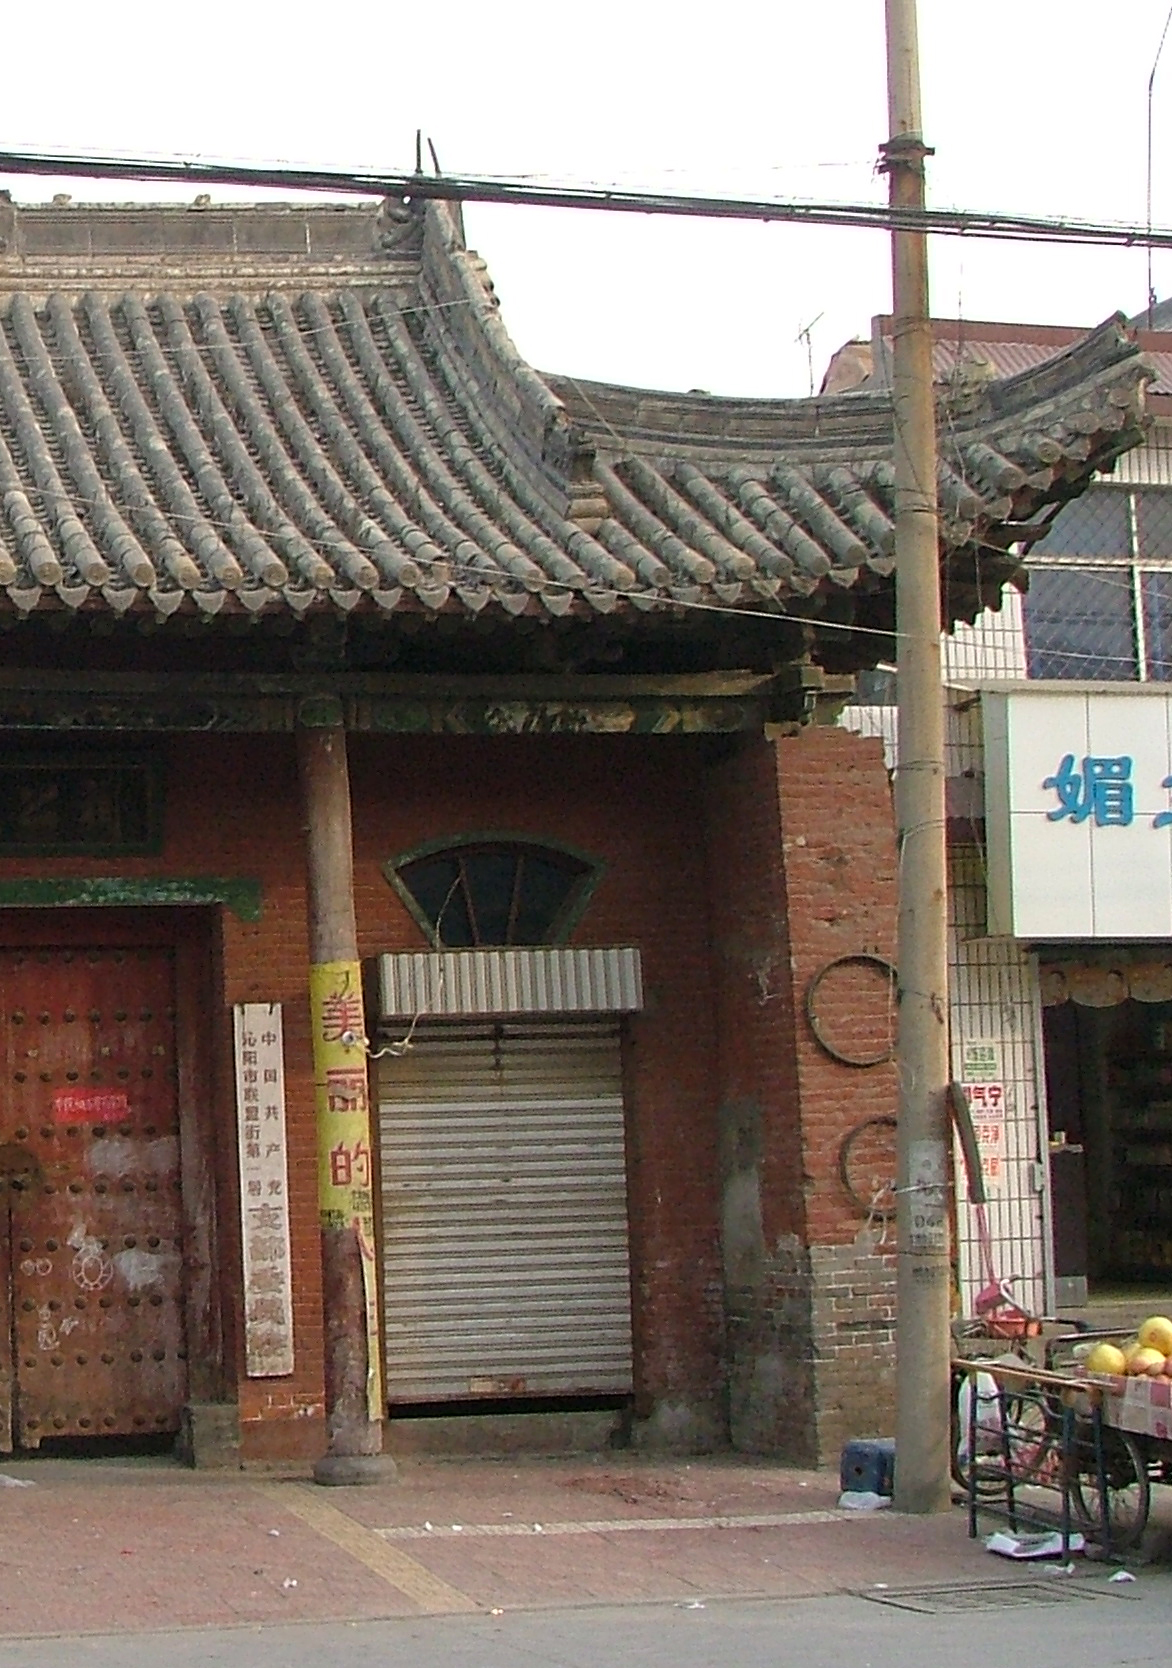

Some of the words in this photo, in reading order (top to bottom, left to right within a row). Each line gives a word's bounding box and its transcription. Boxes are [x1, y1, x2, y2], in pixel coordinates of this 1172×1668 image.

[1042, 754, 1172, 829] 媚
[261, 1031, 283, 1196] 中国共产党
